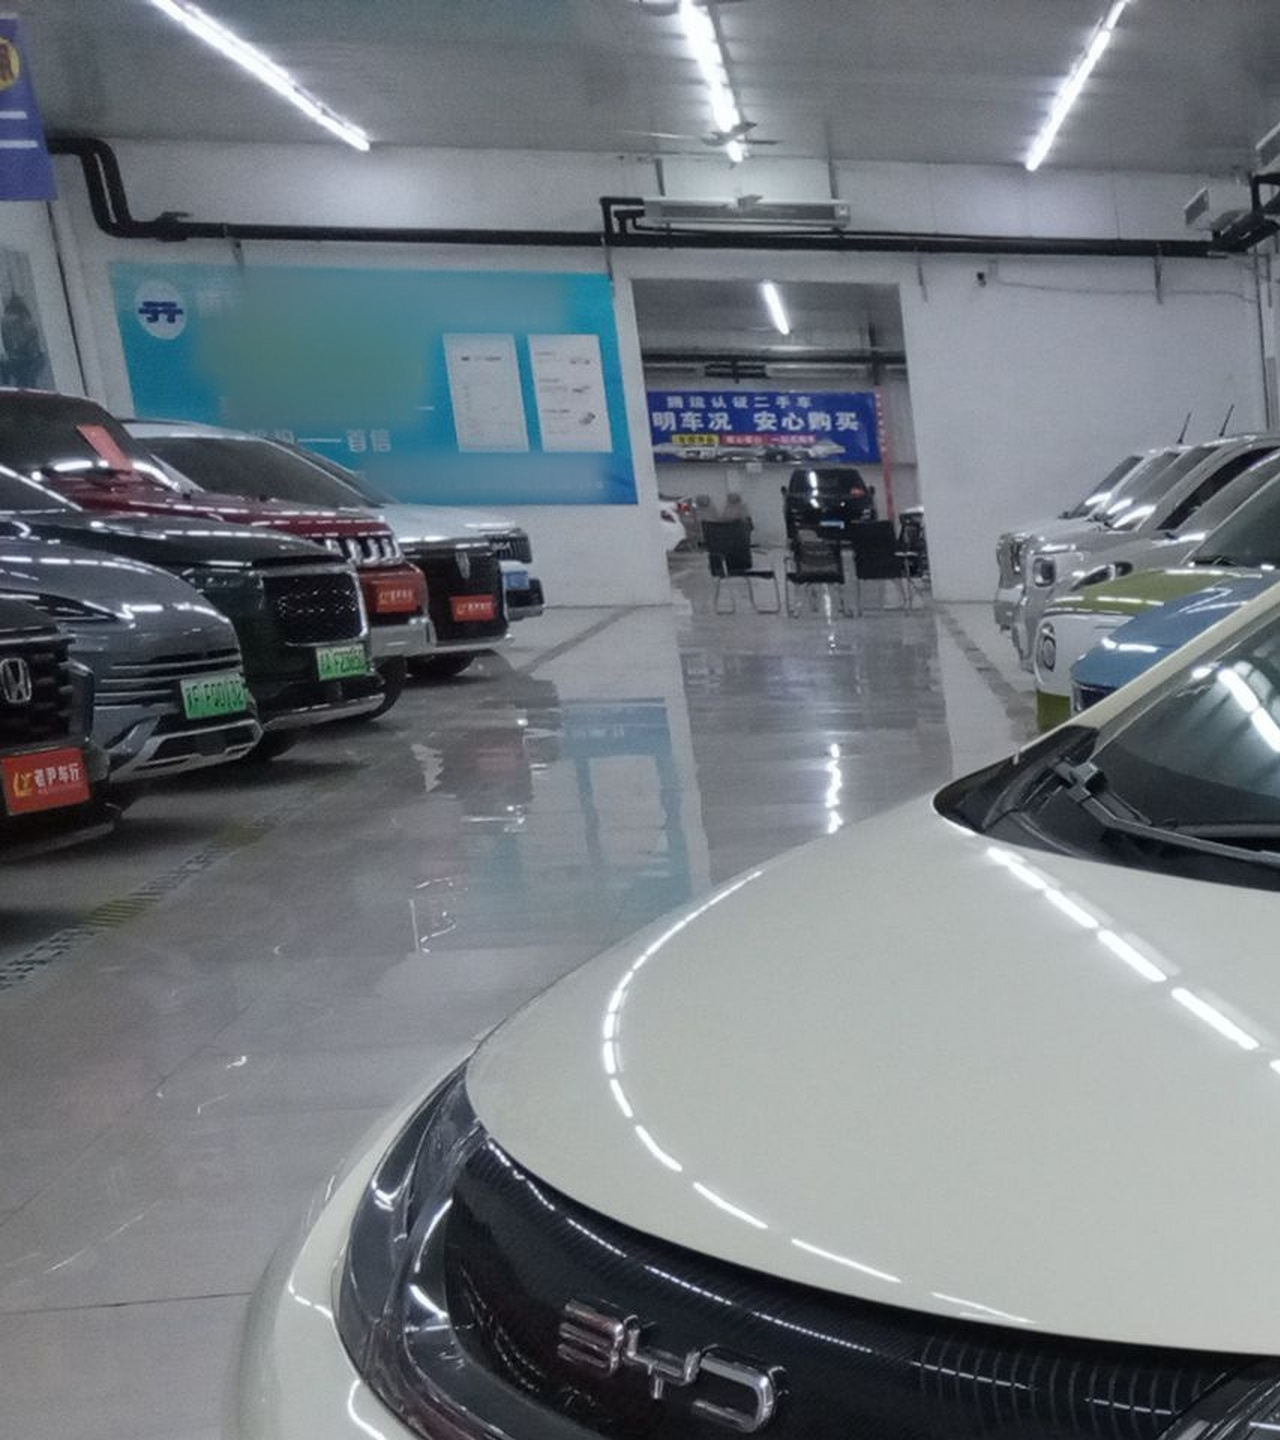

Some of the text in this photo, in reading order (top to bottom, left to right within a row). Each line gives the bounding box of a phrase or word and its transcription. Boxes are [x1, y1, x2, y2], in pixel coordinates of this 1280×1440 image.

[652, 411, 859, 431] 明车况 安心购买
[557, 1299, 774, 1433] BYD
